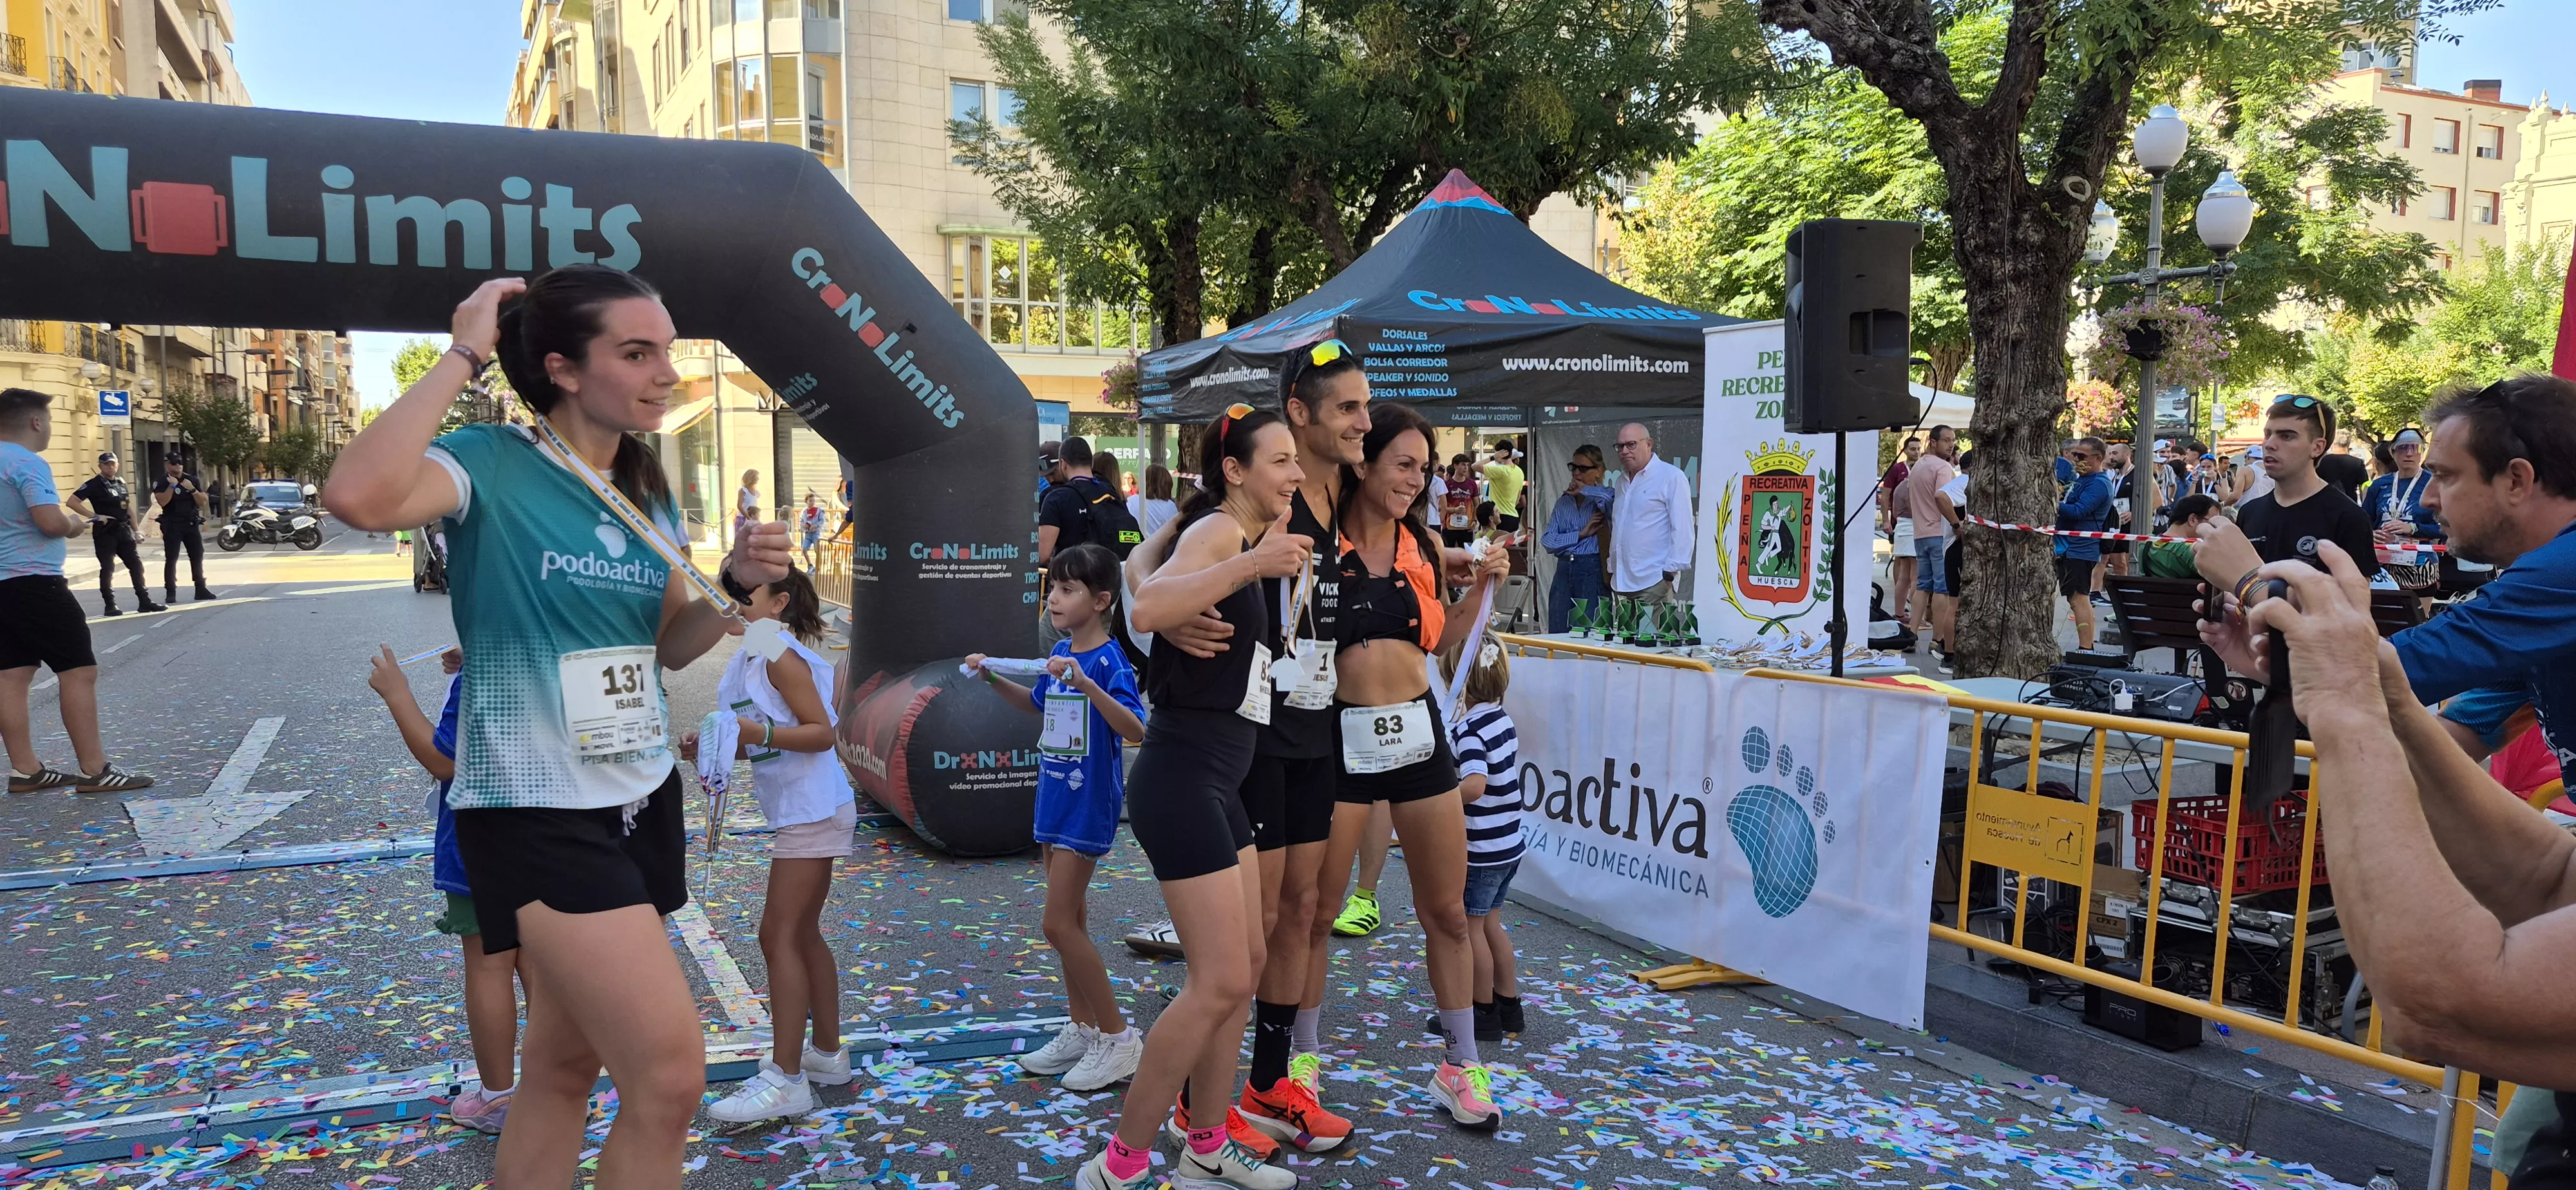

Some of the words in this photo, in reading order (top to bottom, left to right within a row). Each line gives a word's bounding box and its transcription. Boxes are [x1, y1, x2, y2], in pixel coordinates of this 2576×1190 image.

[1382, 328, 1428, 341] DORSALES
[1368, 343, 1405, 352] VALLAS
[1406, 344, 1413, 352] Y
[1415, 344, 1445, 352] ARCOS
[1364, 357, 1394, 367] BOLSA
[1396, 357, 1448, 367] CORREDOR
[1502, 354, 1689, 373] www.cronolimits.com
[1757, 350, 1784, 369] PE
[1189, 366, 1271, 388] www.cronolimits.com
[1366, 373, 1404, 382] PEAKER
[1406, 373, 1412, 382] Y
[1414, 373, 1449, 382] SONIDO
[1370, 388, 1397, 397] OFEOS
[1399, 388, 1406, 397] Y
[1407, 388, 1457, 397] MEDALLAS
[1721, 375, 1785, 397] RECRE
[1750, 478, 1808, 489] RECREATIVA
[540, 550, 665, 589] podoactiva
[1757, 577, 1793, 586] HUESCA
[1319, 582, 1340, 596] VICK
[1321, 598, 1338, 608] FOOD
[615, 697, 645, 710] ISABEL
[1374, 715, 1404, 735] 83
[1379, 737, 1403, 746] LARA
[966, 772, 996, 780] Servicio
[1009, 771, 1037, 780] imagen
[973, 780, 1022, 791] promocional
[1519, 757, 1709, 859] oactiva
[1557, 836, 1567, 857] Y
[1569, 840, 1709, 898] BIOMECÁNICA
[2109, 1002, 2136, 1017] PRO
